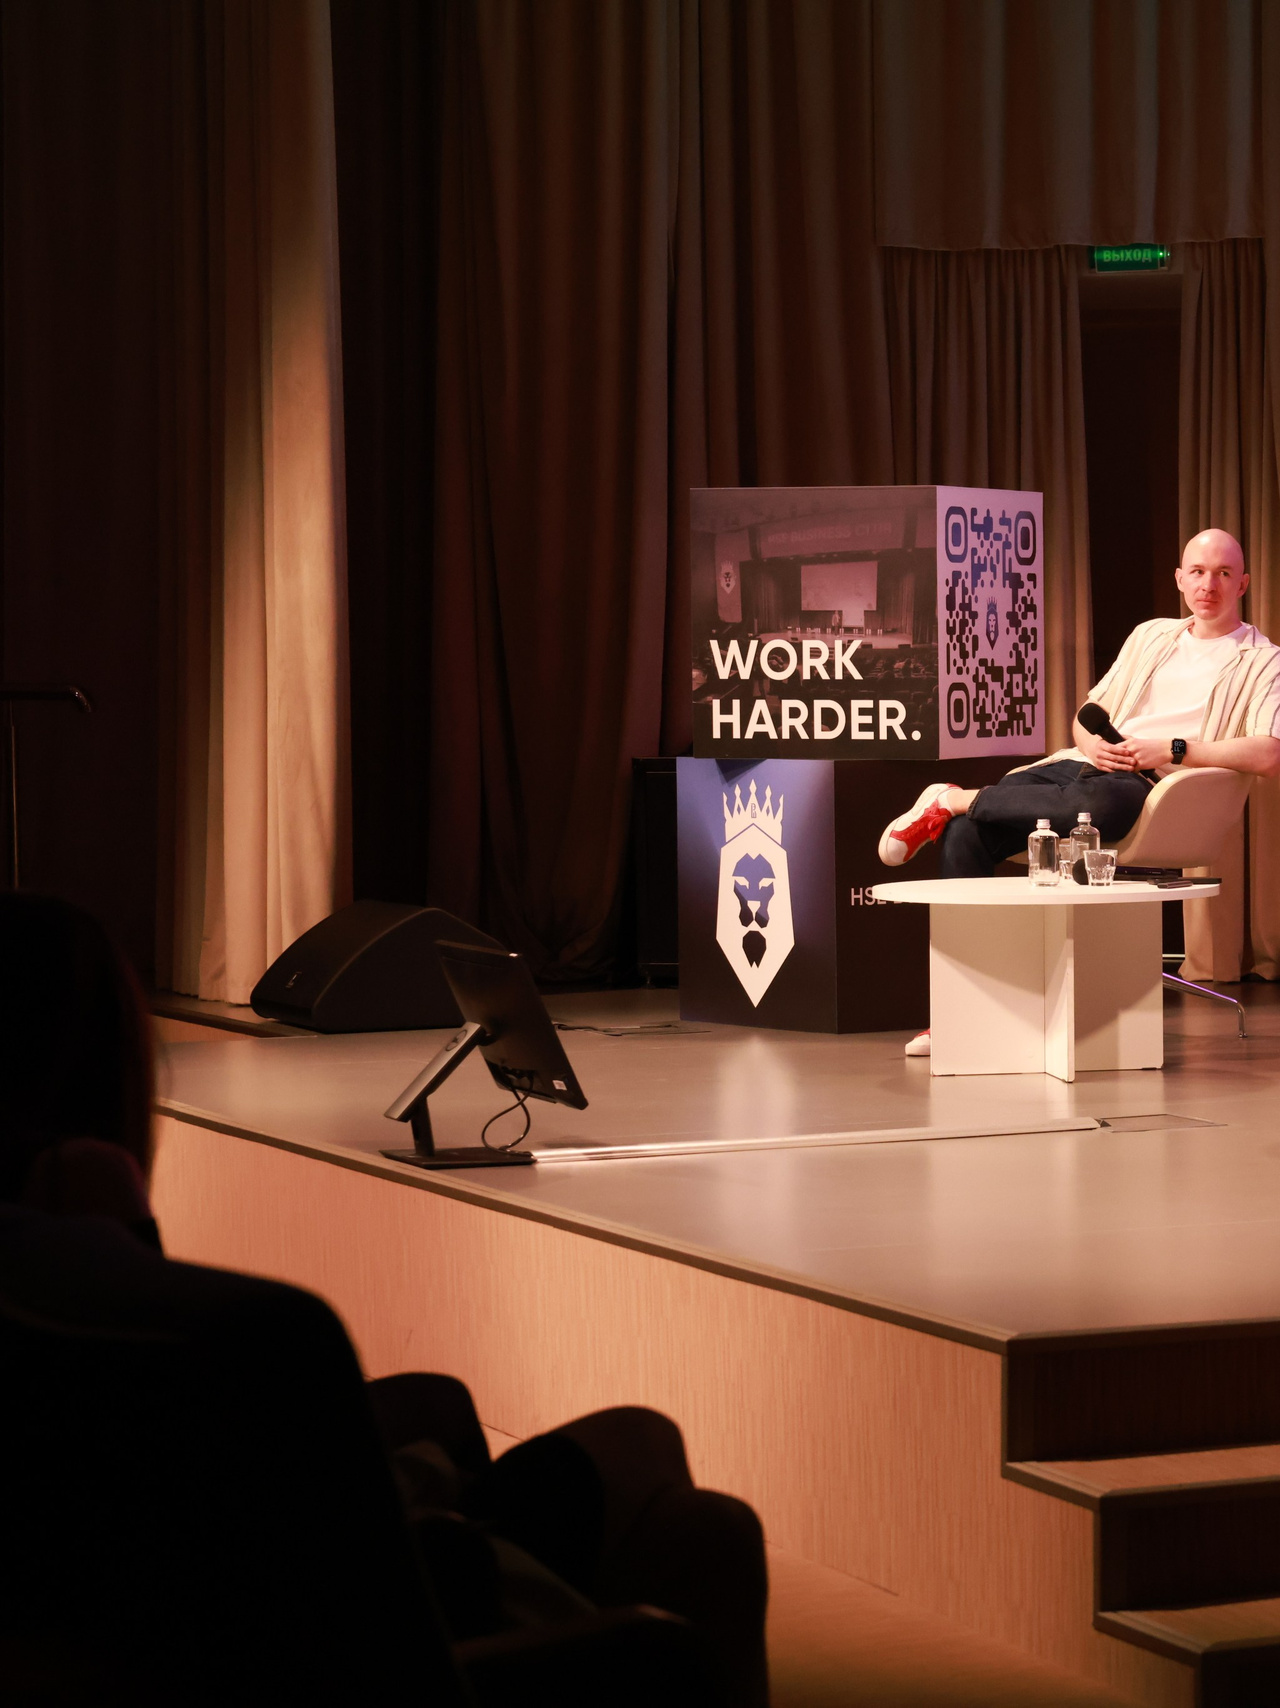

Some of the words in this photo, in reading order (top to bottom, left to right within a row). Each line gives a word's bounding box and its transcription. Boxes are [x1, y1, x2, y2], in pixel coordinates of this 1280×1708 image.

[1103, 248, 1152, 263] ВЫХОД
[709, 638, 864, 681] WORK
[711, 699, 922, 741] HARDER.
[850, 886, 887, 906] HS
